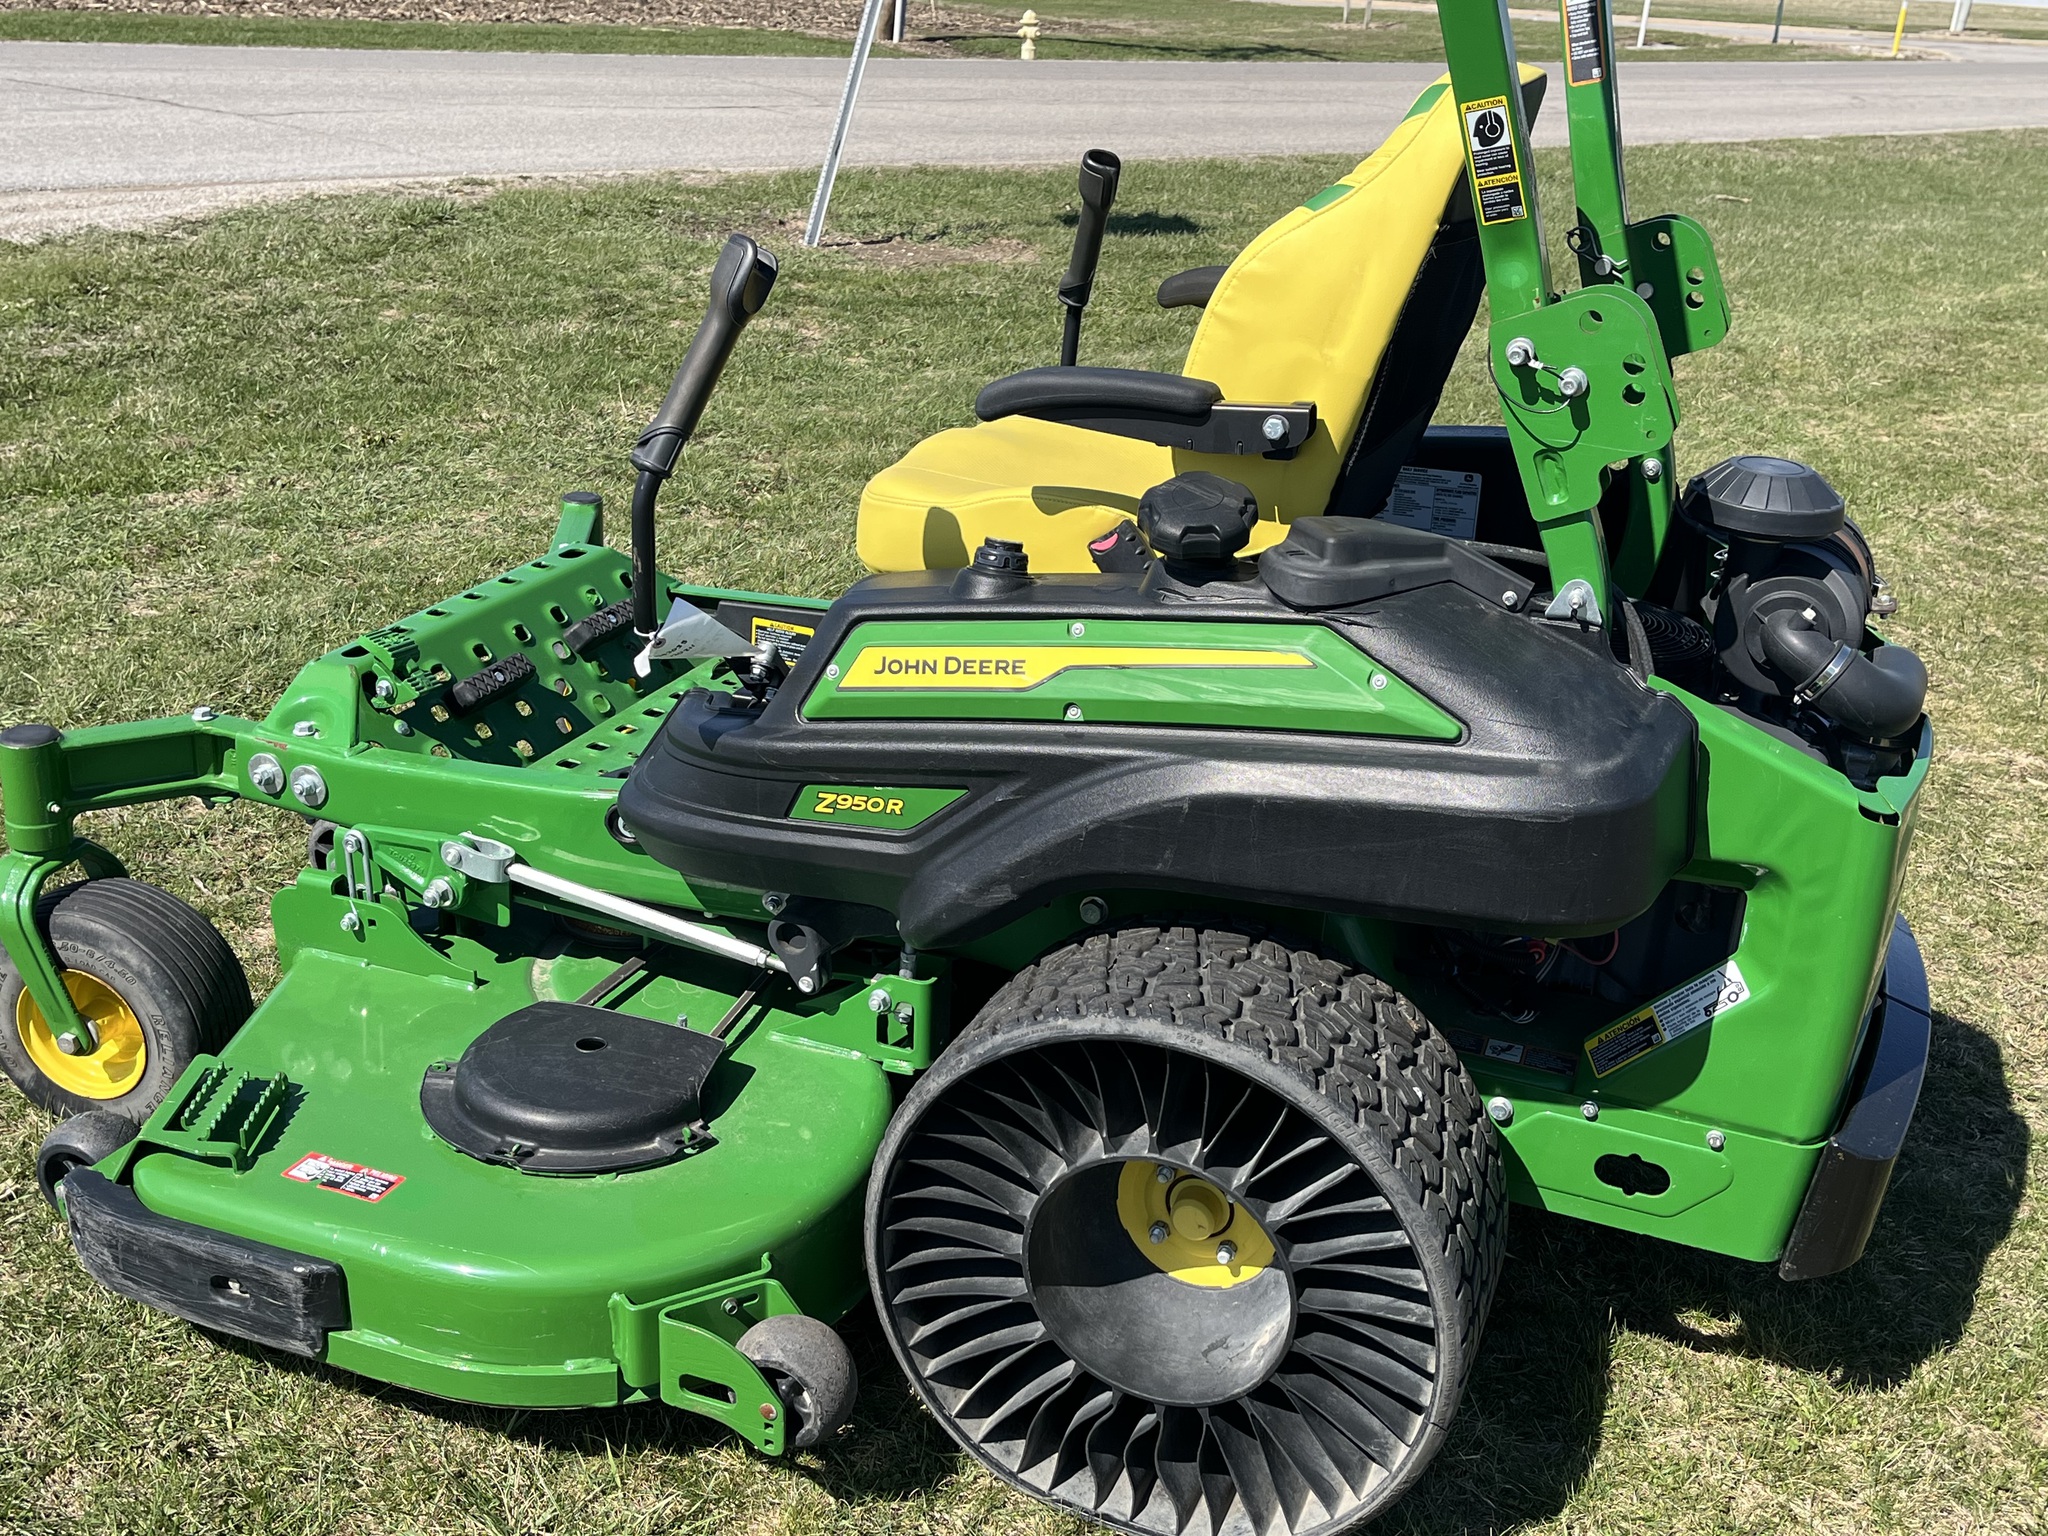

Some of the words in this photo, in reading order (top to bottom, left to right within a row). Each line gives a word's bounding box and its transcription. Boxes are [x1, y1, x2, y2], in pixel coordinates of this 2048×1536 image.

[1471, 98, 1503, 110] CAUTION
[1483, 173, 1518, 187] ATENCIÓN
[874, 656, 937, 675] JOHN
[944, 656, 1026, 675] DEERE
[813, 791, 904, 816] Z950R
[1604, 1016, 1641, 1041] ATENCIÓN
[1302, 1093, 1391, 1175] MICHELIN
[1445, 1312, 1456, 1334] NOT
[1447, 1337, 1457, 1360] FOR
[1440, 1366, 1455, 1412] HIGHWAY
